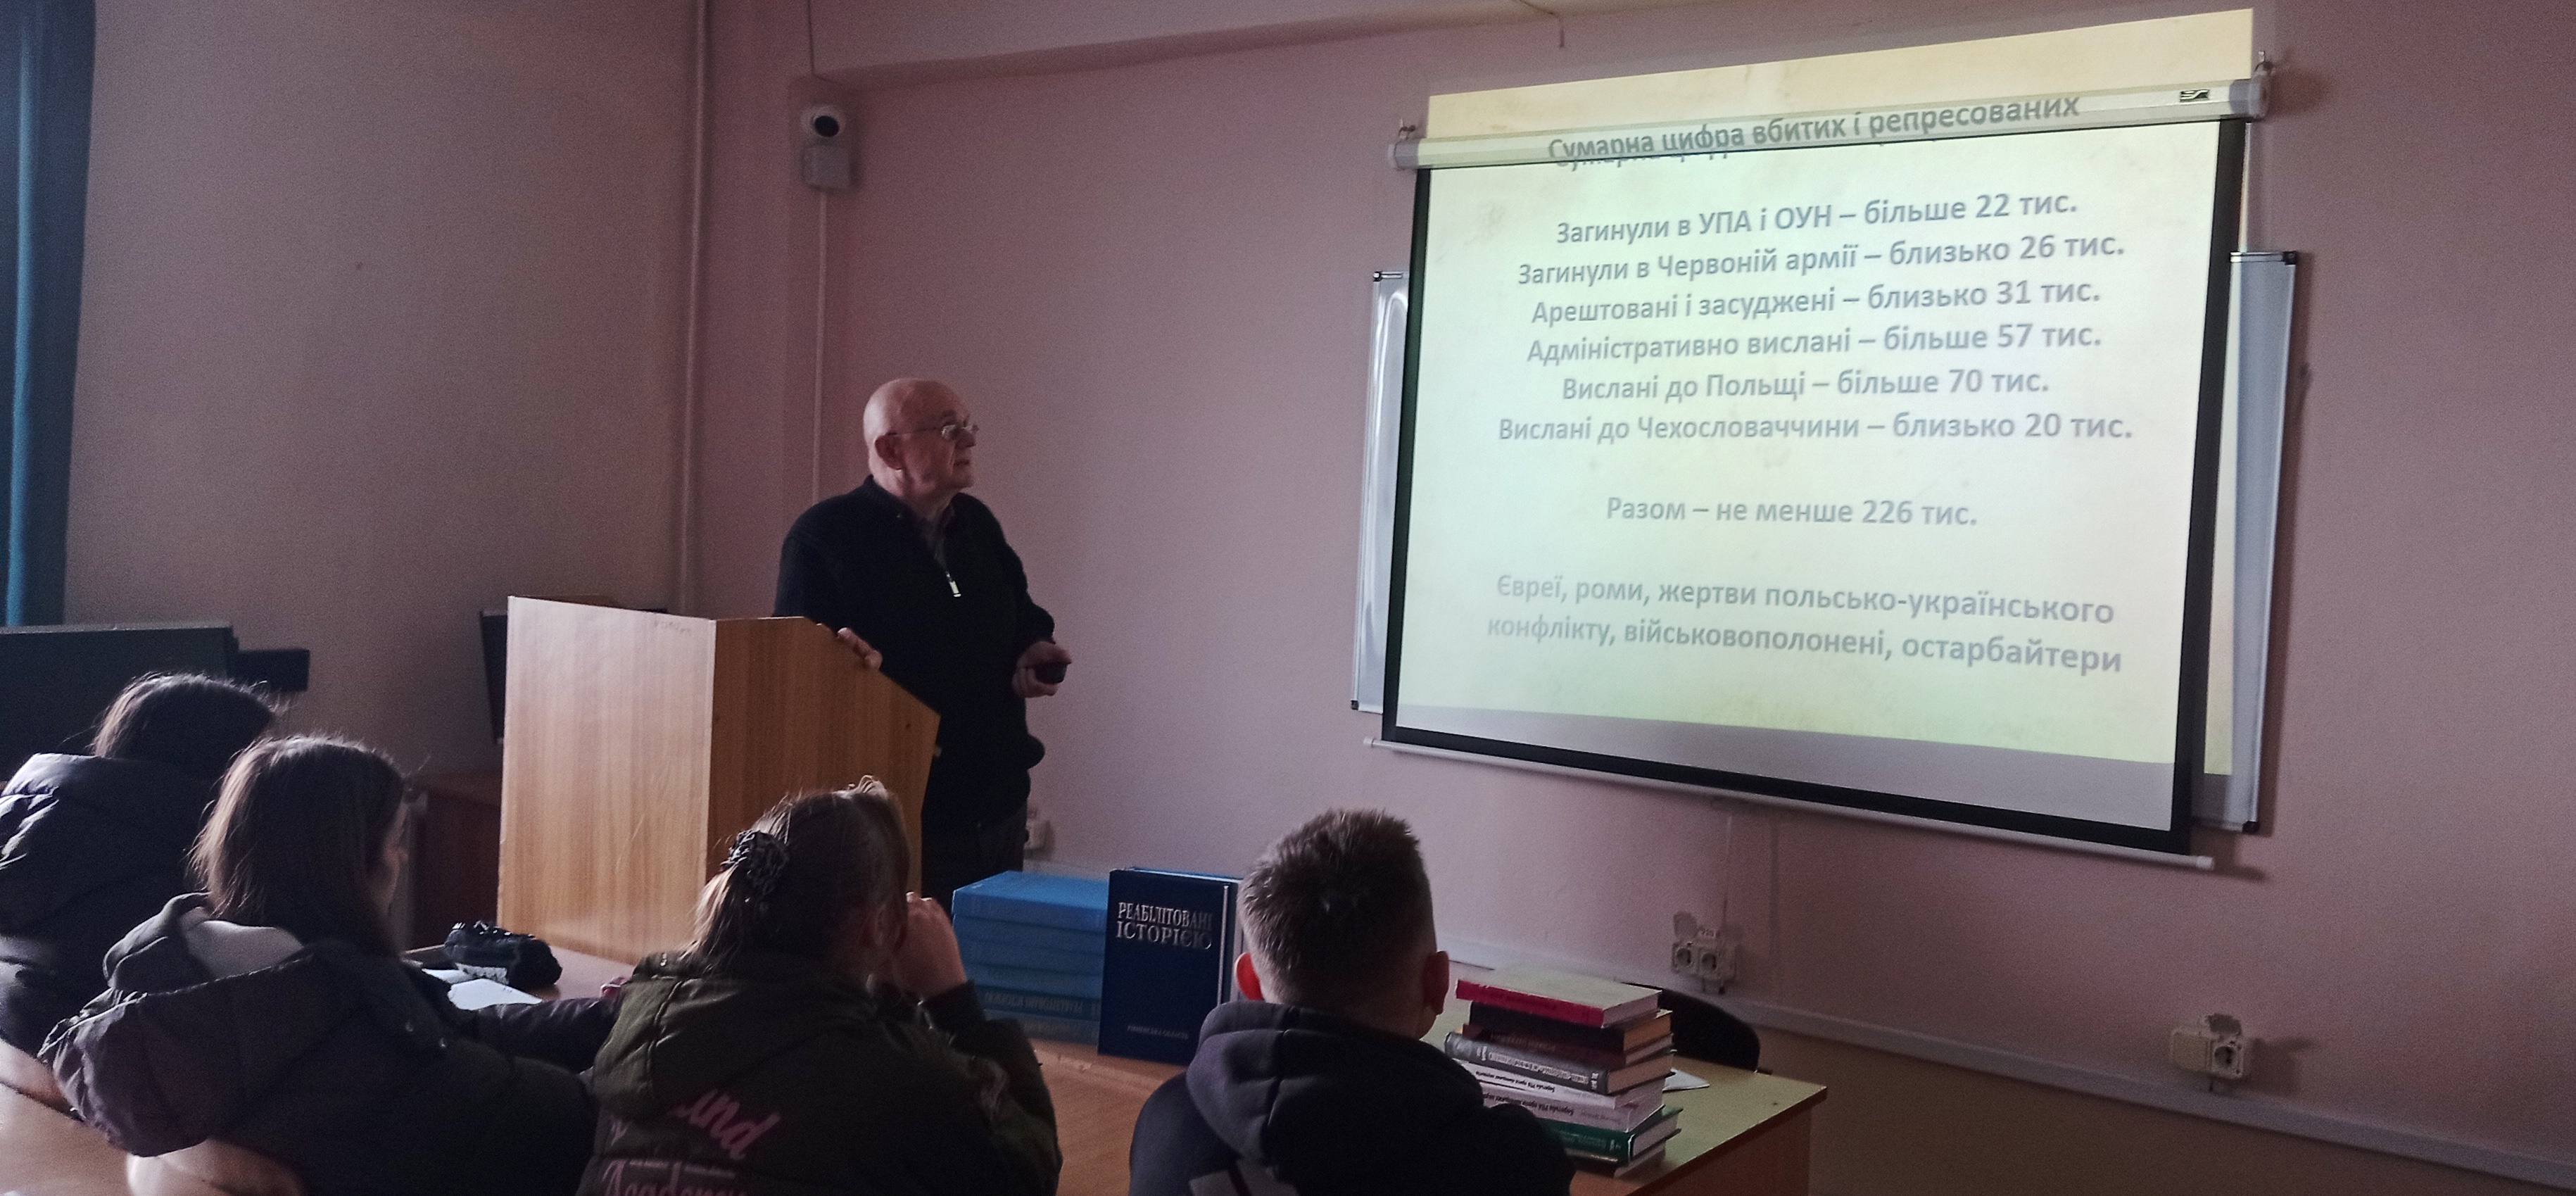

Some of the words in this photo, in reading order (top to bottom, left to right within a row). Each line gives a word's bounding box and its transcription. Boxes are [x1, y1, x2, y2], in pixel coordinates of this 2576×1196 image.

[1548, 135, 1655, 163] Сумарна
[1662, 123, 1745, 156] цифра
[1753, 116, 1846, 145] вбитих
[1854, 111, 1862, 136] і
[1869, 96, 2081, 138] репресованих
[1557, 220, 1669, 245] Загинули
[1677, 219, 1691, 237] в
[1698, 210, 1752, 235] УПА
[1760, 207, 1767, 231] і
[1774, 204, 1832, 230] ОУН
[1864, 199, 1966, 225] більше
[1975, 193, 2010, 218] 22
[2019, 195, 2078, 215] тис.
[1518, 263, 1629, 287] Загинули
[1636, 262, 1650, 279] в
[1658, 248, 1777, 280] Червоній
[1786, 244, 1859, 276] армії
[1889, 239, 2011, 266] близько
[2019, 234, 2056, 260] 26
[2064, 237, 2125, 257] тис.
[1532, 294, 1678, 328] Арештовані
[1686, 293, 1692, 316] і
[1698, 286, 1835, 320] засуджені
[1868, 284, 1988, 310] близько
[1997, 279, 2031, 305] 31
[2040, 283, 2100, 303] тис.
[1527, 336, 1739, 366] Адміністративно
[1748, 327, 1850, 355] вислані
[1883, 325, 1988, 351] більше
[1997, 322, 2033, 348] 57
[2042, 327, 2101, 347] тис.
[1563, 374, 1658, 400] Вислані
[1665, 380, 1698, 403] до
[1706, 371, 1805, 401] Польщі
[1837, 369, 1939, 394] більше
[1949, 369, 1983, 393] 70
[1991, 373, 2049, 392] тис.
[1499, 416, 1591, 440] Вислані
[1597, 422, 1629, 444] до
[1638, 417, 1859, 439] Чехословаччини
[1893, 411, 2015, 437] близько
[2025, 413, 2062, 437] 20
[2070, 418, 2133, 439] тис.
[1608, 497, 1686, 520] Разом
[1717, 503, 1748, 521] не
[1756, 504, 1853, 522] менше
[1862, 500, 1913, 524] 226
[1921, 506, 1976, 525] тис.
[1498, 575, 1566, 602] Євреї,
[1576, 583, 1650, 605] роми,
[1659, 585, 1756, 609] жертви
[1766, 588, 2114, 624] польсько-українського
[1489, 615, 1615, 646] конфлікту,
[1625, 619, 1891, 660] військовополонені,
[1902, 636, 2121, 676] остарбайтери
[1116, 920, 1213, 950] ІСТОРІЄЮ
[1118, 902, 1213, 931] РЕАБІЛІТОВАНІ
